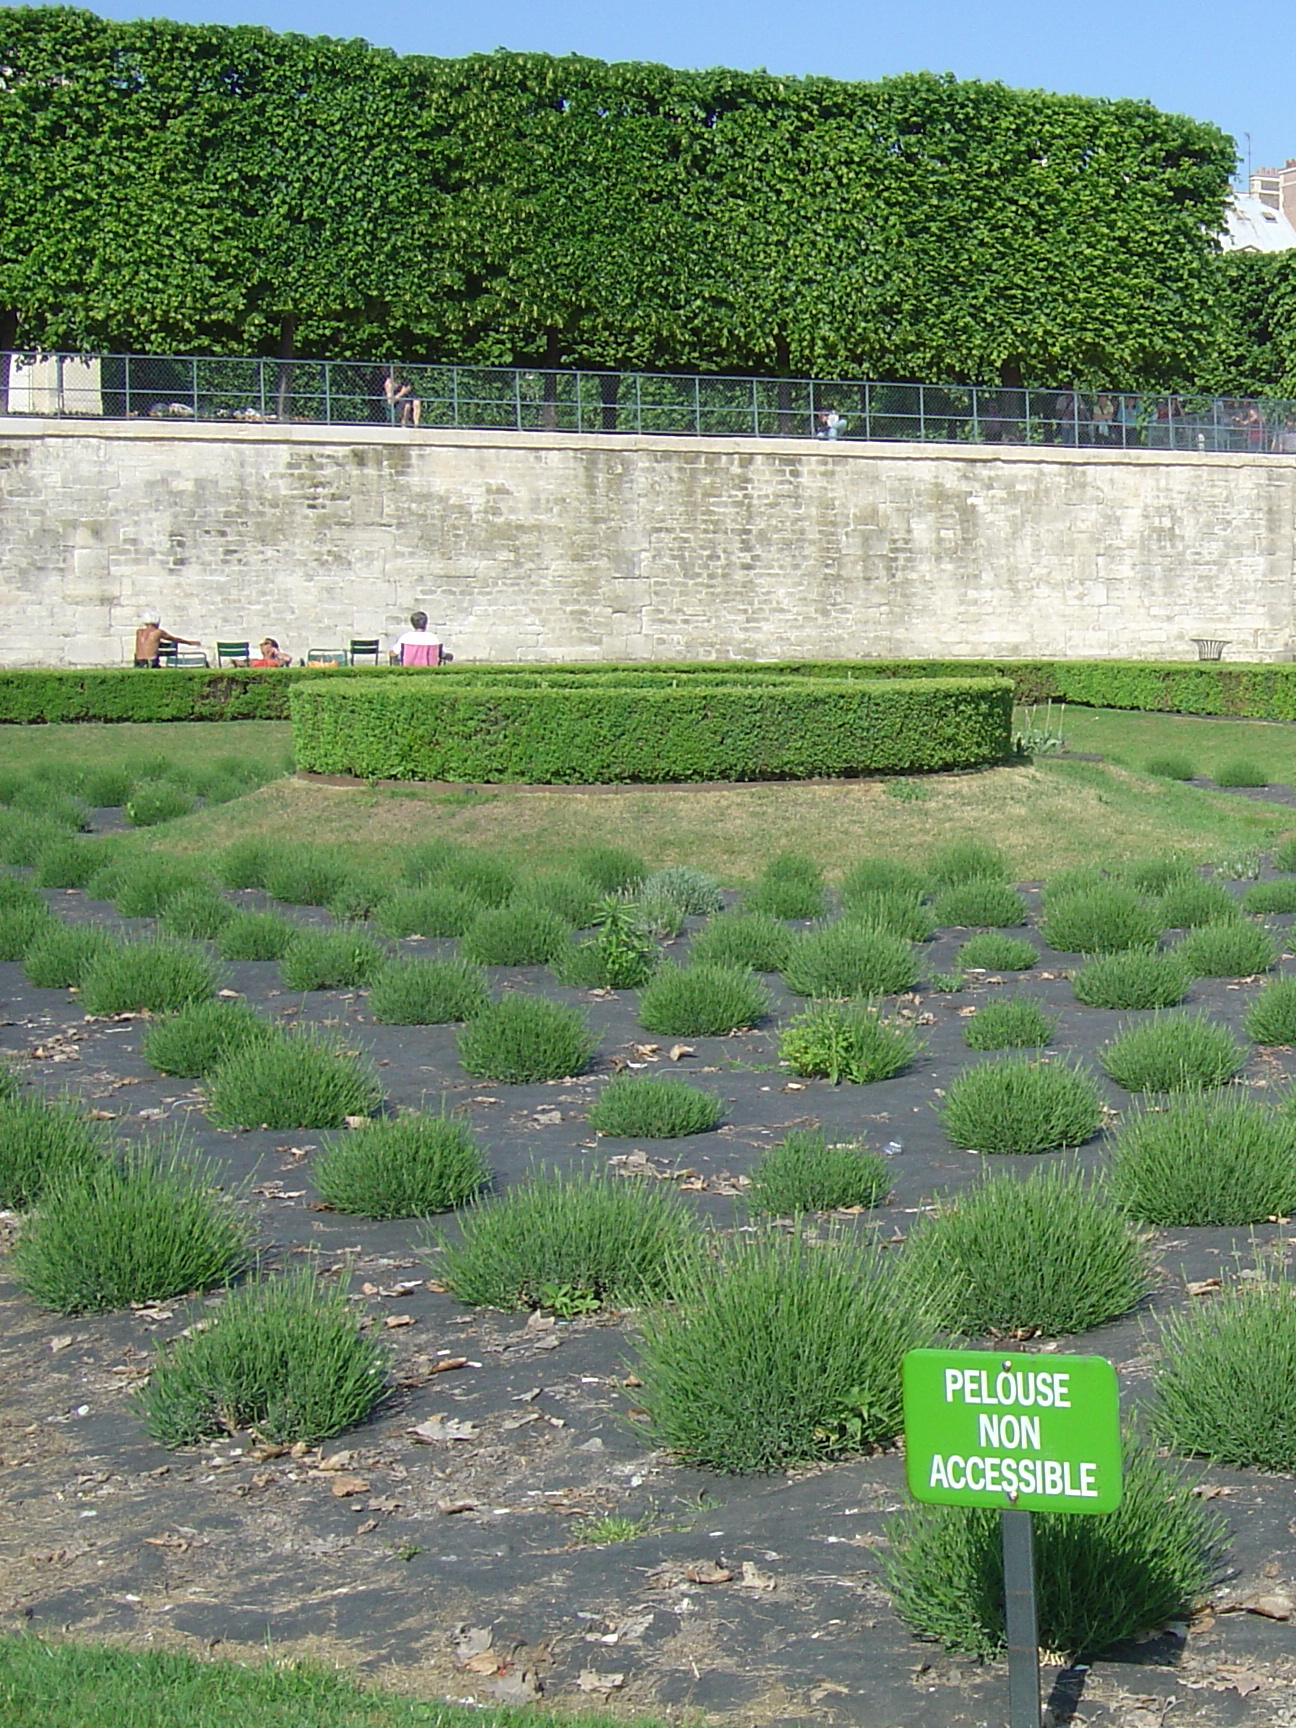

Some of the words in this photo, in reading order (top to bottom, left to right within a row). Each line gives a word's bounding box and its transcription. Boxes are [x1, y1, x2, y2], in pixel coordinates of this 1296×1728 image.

[945, 1369, 1071, 1407] PELOUSE
[979, 1414, 1041, 1450] NON
[930, 1455, 1098, 1497] ACCESSIBLE
